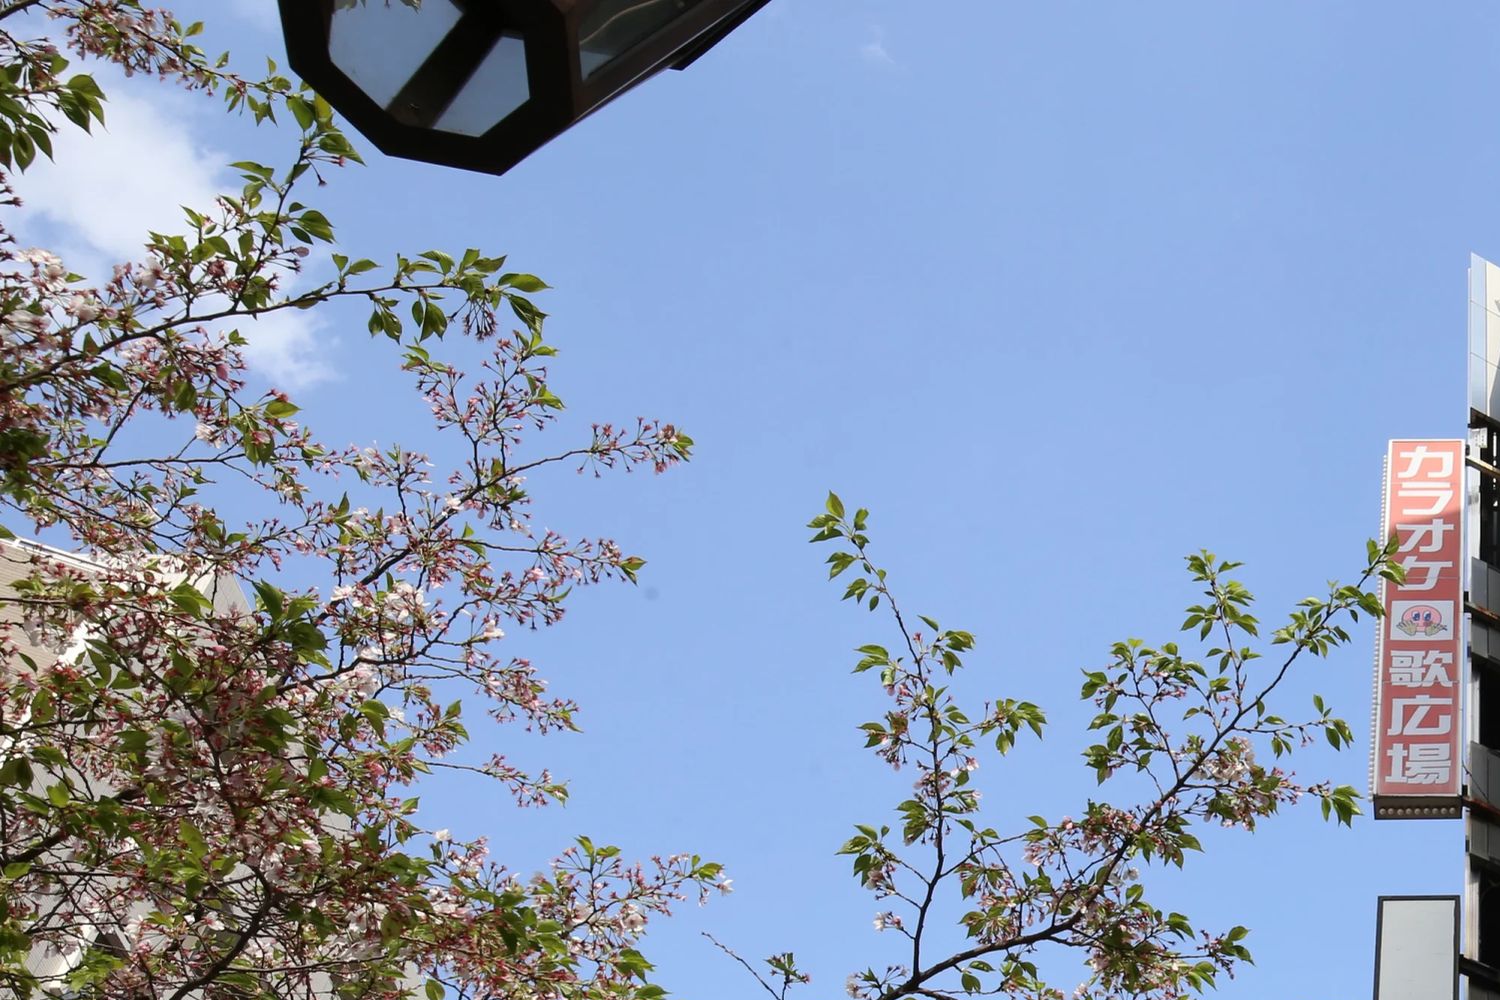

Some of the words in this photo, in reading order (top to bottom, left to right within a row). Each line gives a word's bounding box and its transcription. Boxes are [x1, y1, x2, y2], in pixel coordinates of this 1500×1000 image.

[1396, 445, 1454, 591] カラオケ
[1385, 650, 1453, 785] 歌広場
